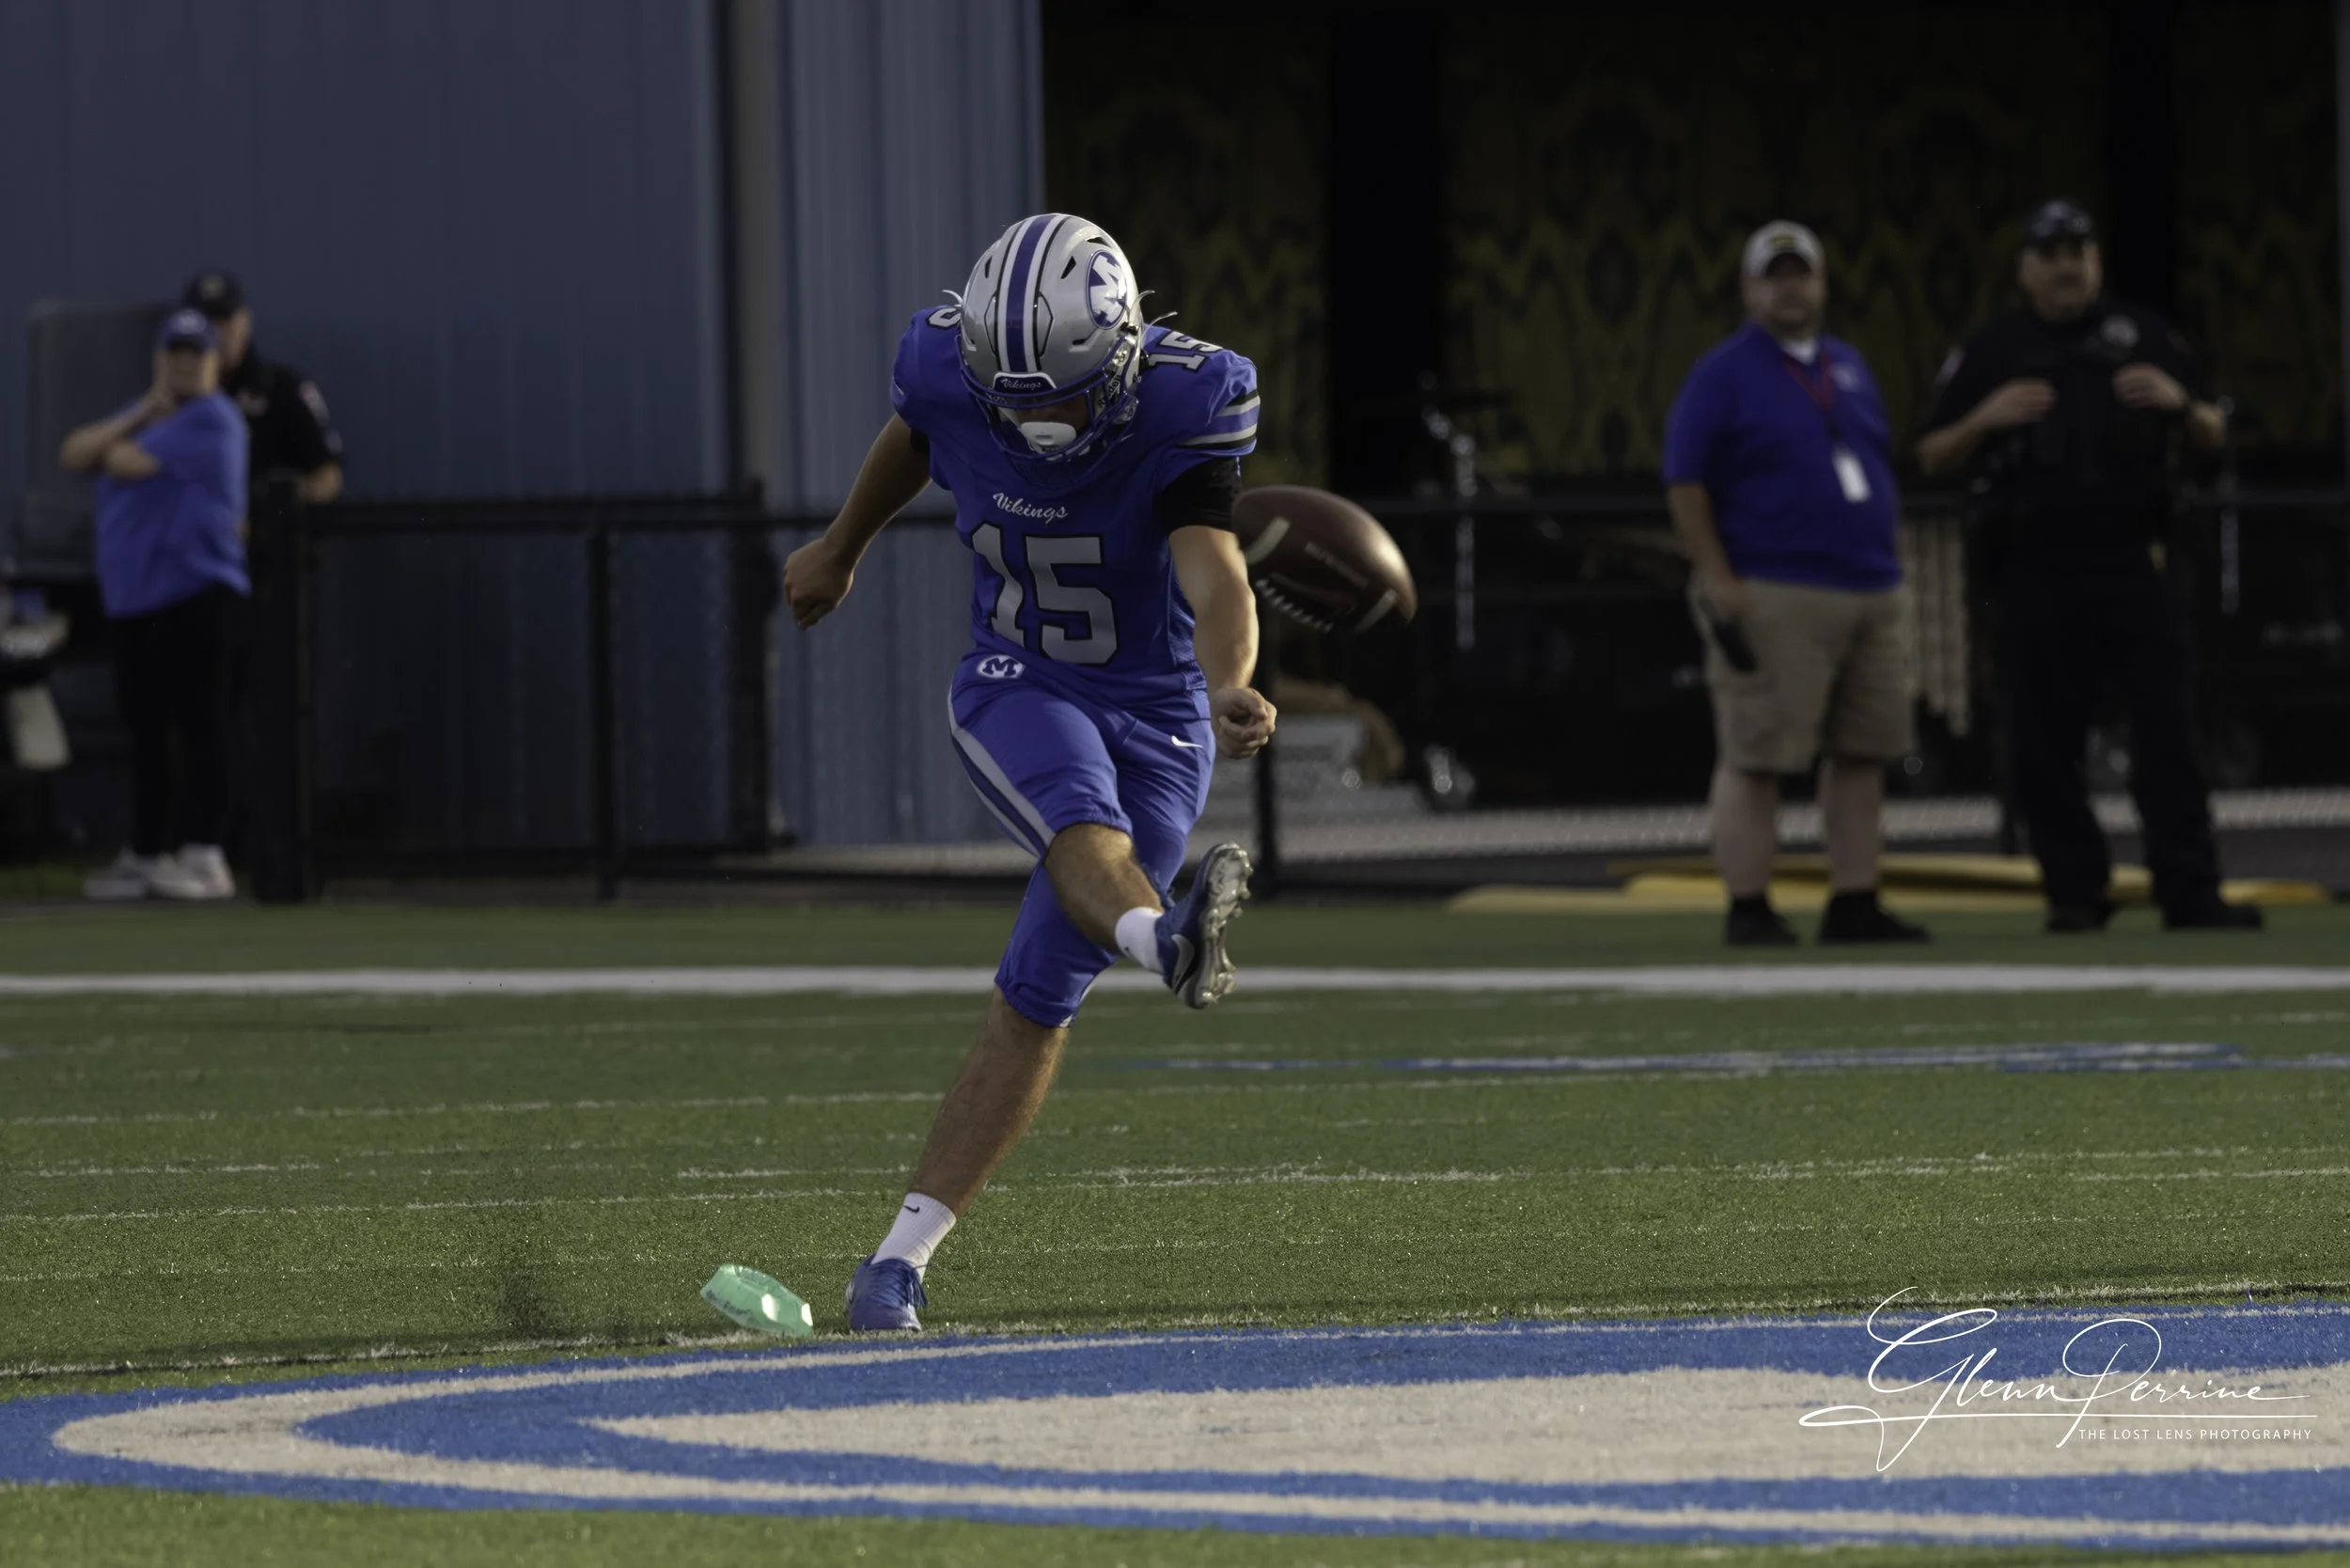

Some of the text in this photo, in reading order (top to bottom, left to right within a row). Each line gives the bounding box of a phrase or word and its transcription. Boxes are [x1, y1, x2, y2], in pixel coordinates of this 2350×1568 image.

[1088, 253, 1127, 323] M
[1148, 330, 1224, 371] 15
[1001, 378, 1042, 391] Vikings
[993, 492, 1068, 524] Vikings
[972, 522, 1119, 665] 15
[980, 657, 1019, 677] M
